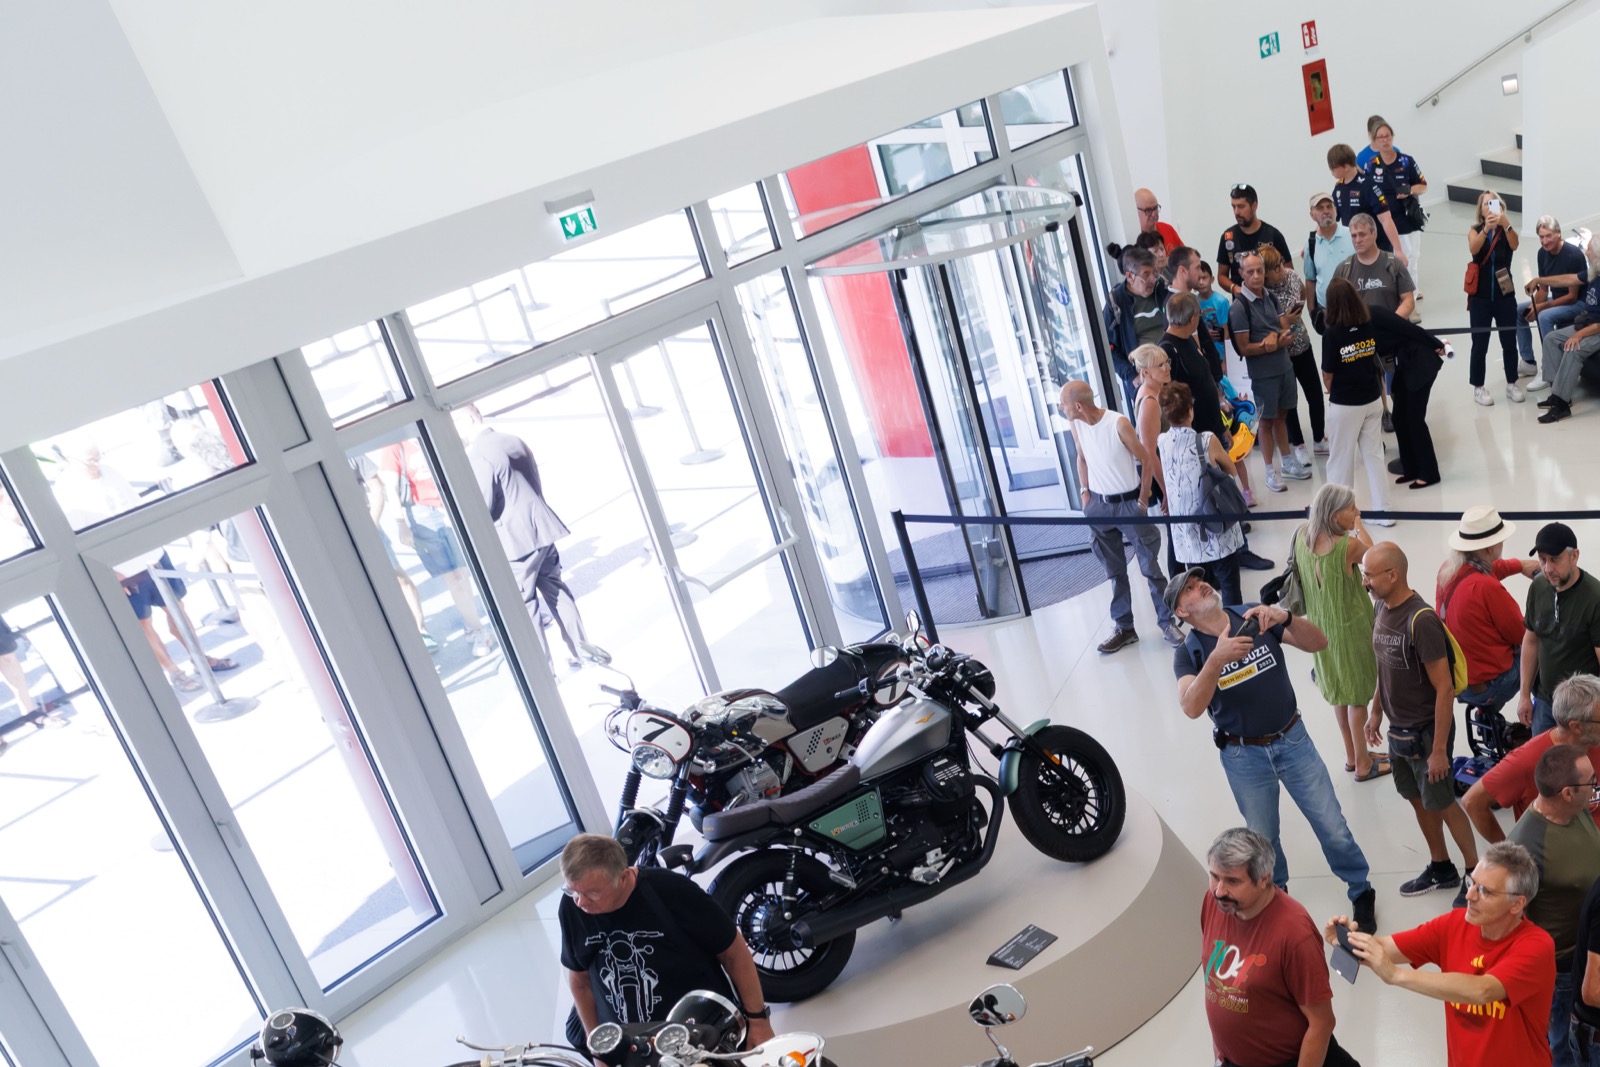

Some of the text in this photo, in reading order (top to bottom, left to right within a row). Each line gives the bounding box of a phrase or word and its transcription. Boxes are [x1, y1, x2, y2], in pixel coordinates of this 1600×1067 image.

[1220, 677, 1235, 686] OPEN
[1235, 668, 1253, 680] HOUSE
[642, 717, 675, 742] 7
[1219, 996, 1249, 1013] GUZZI
